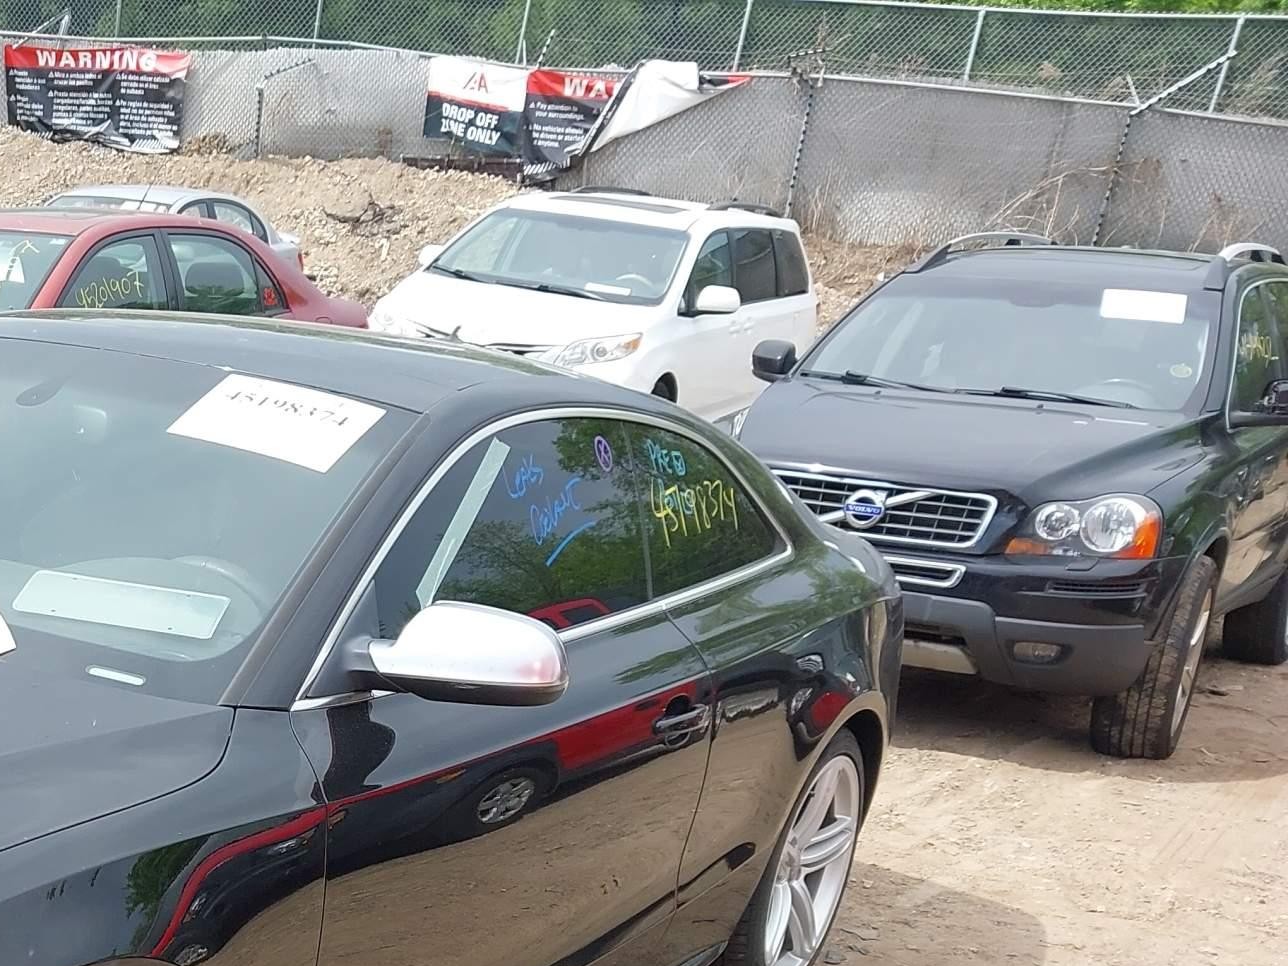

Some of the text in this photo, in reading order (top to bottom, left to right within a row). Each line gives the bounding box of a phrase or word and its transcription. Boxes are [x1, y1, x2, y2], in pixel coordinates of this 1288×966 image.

[36, 50, 158, 72] WARNING
[442, 102, 499, 129] DROP OFF
[535, 101, 546, 111] Pay
[466, 126, 501, 146] ONLY
[540, 132, 557, 140] driven
[542, 124, 565, 133] vehicles
[75, 270, 145, 308] 45201907
[650, 478, 739, 549] 45198374
[848, 503, 880, 514] VOLVO
